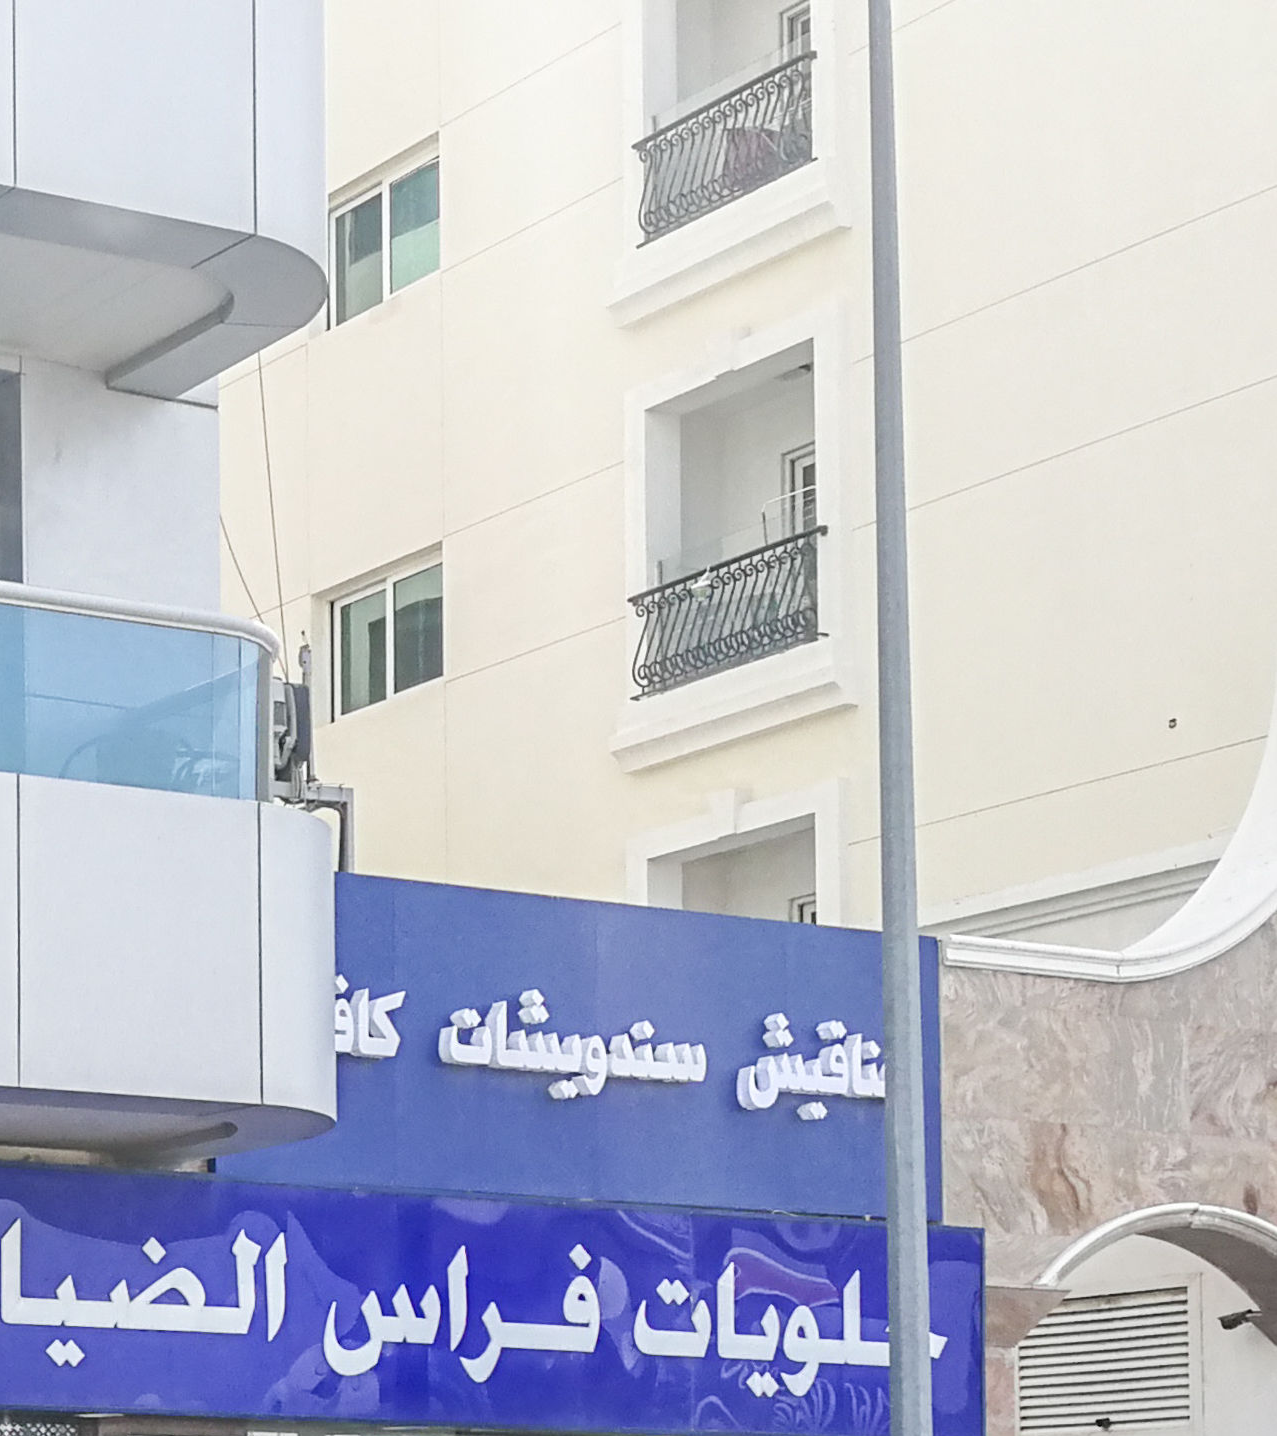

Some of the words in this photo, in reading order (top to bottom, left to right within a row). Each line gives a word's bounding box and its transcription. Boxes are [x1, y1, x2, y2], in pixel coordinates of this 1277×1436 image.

[334, 973, 407, 1059] كاف
[439, 988, 707, 1100] سندويشات
[736, 1012, 886, 1121] ناقيش
[323, 1243, 601, 1384] فراس
